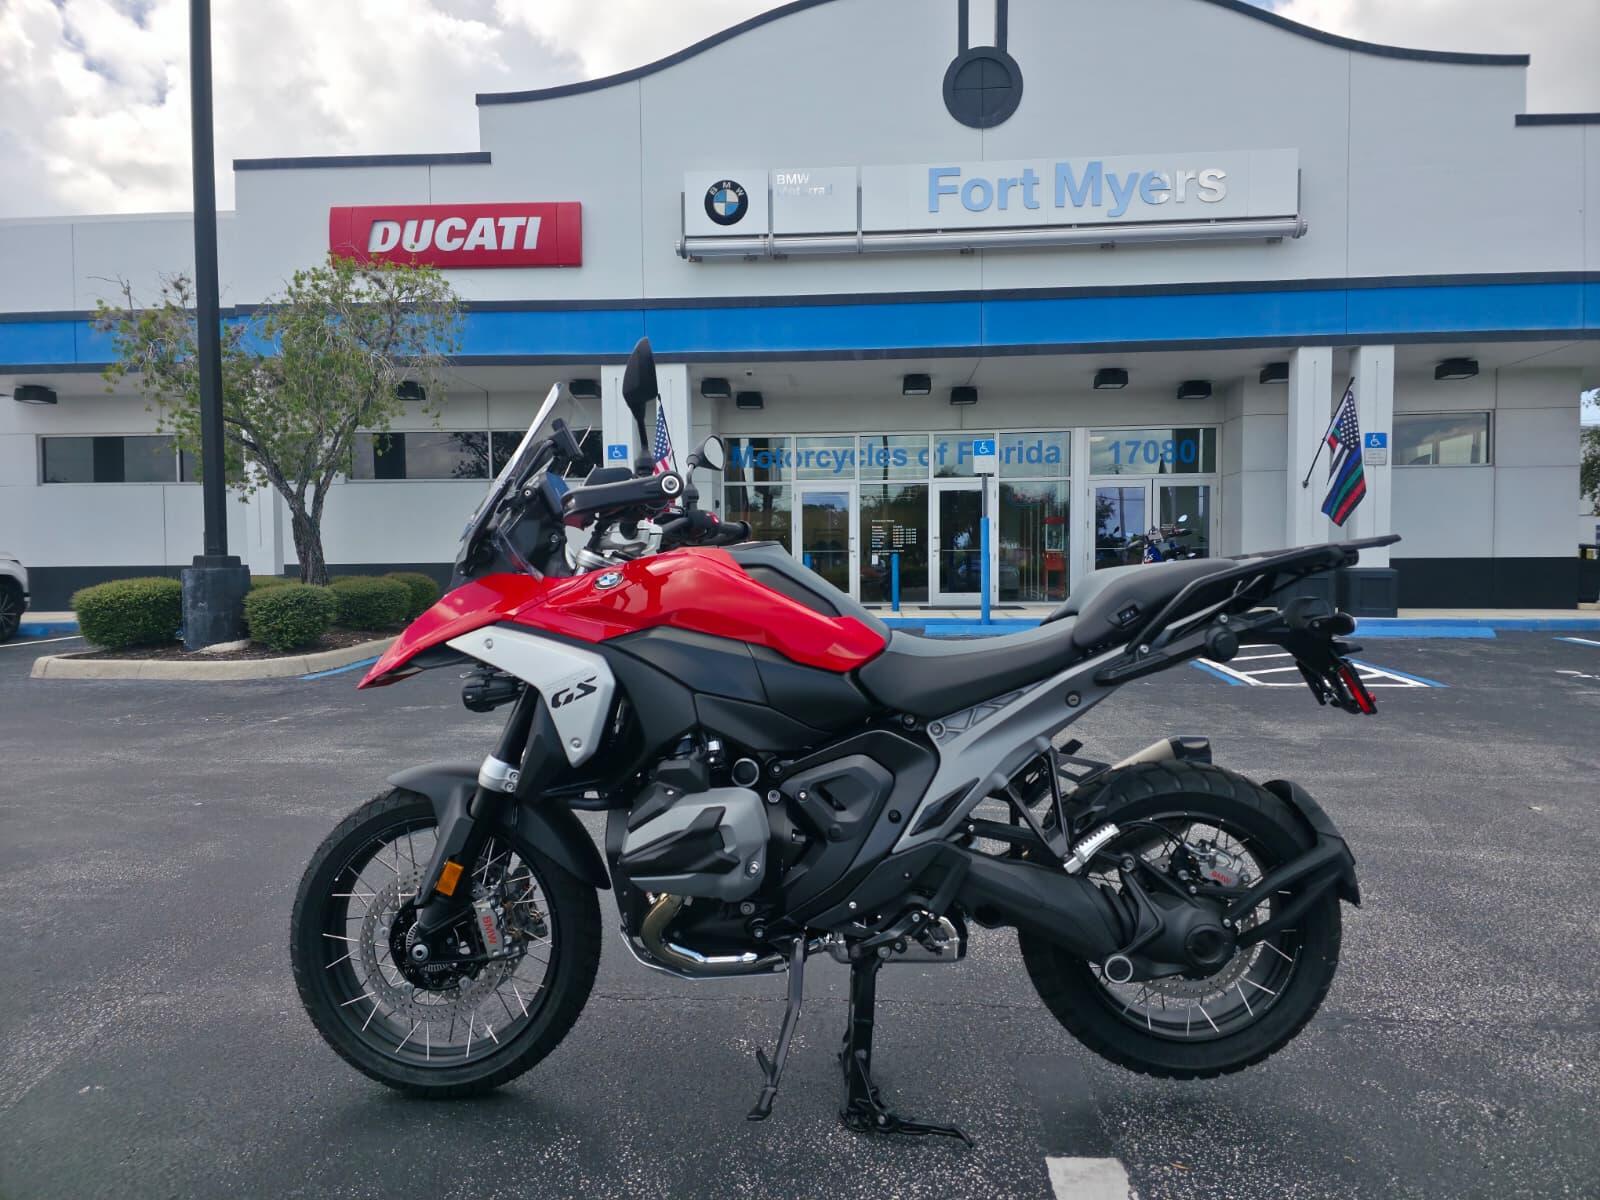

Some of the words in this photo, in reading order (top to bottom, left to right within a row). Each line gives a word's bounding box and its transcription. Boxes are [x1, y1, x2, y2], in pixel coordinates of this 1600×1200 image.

[710, 181, 745, 196] BMW
[776, 173, 809, 185] BMW
[928, 167, 1040, 213] Fort
[1055, 161, 1227, 217] Myers
[368, 216, 542, 253] DUCATI
[731, 443, 908, 473] Motorcycles
[918, 442, 948, 467] of
[957, 440, 1061, 465] Frida
[1108, 439, 1196, 466] 17080
[551, 675, 598, 709] GS
[482, 915, 498, 945] BMW
